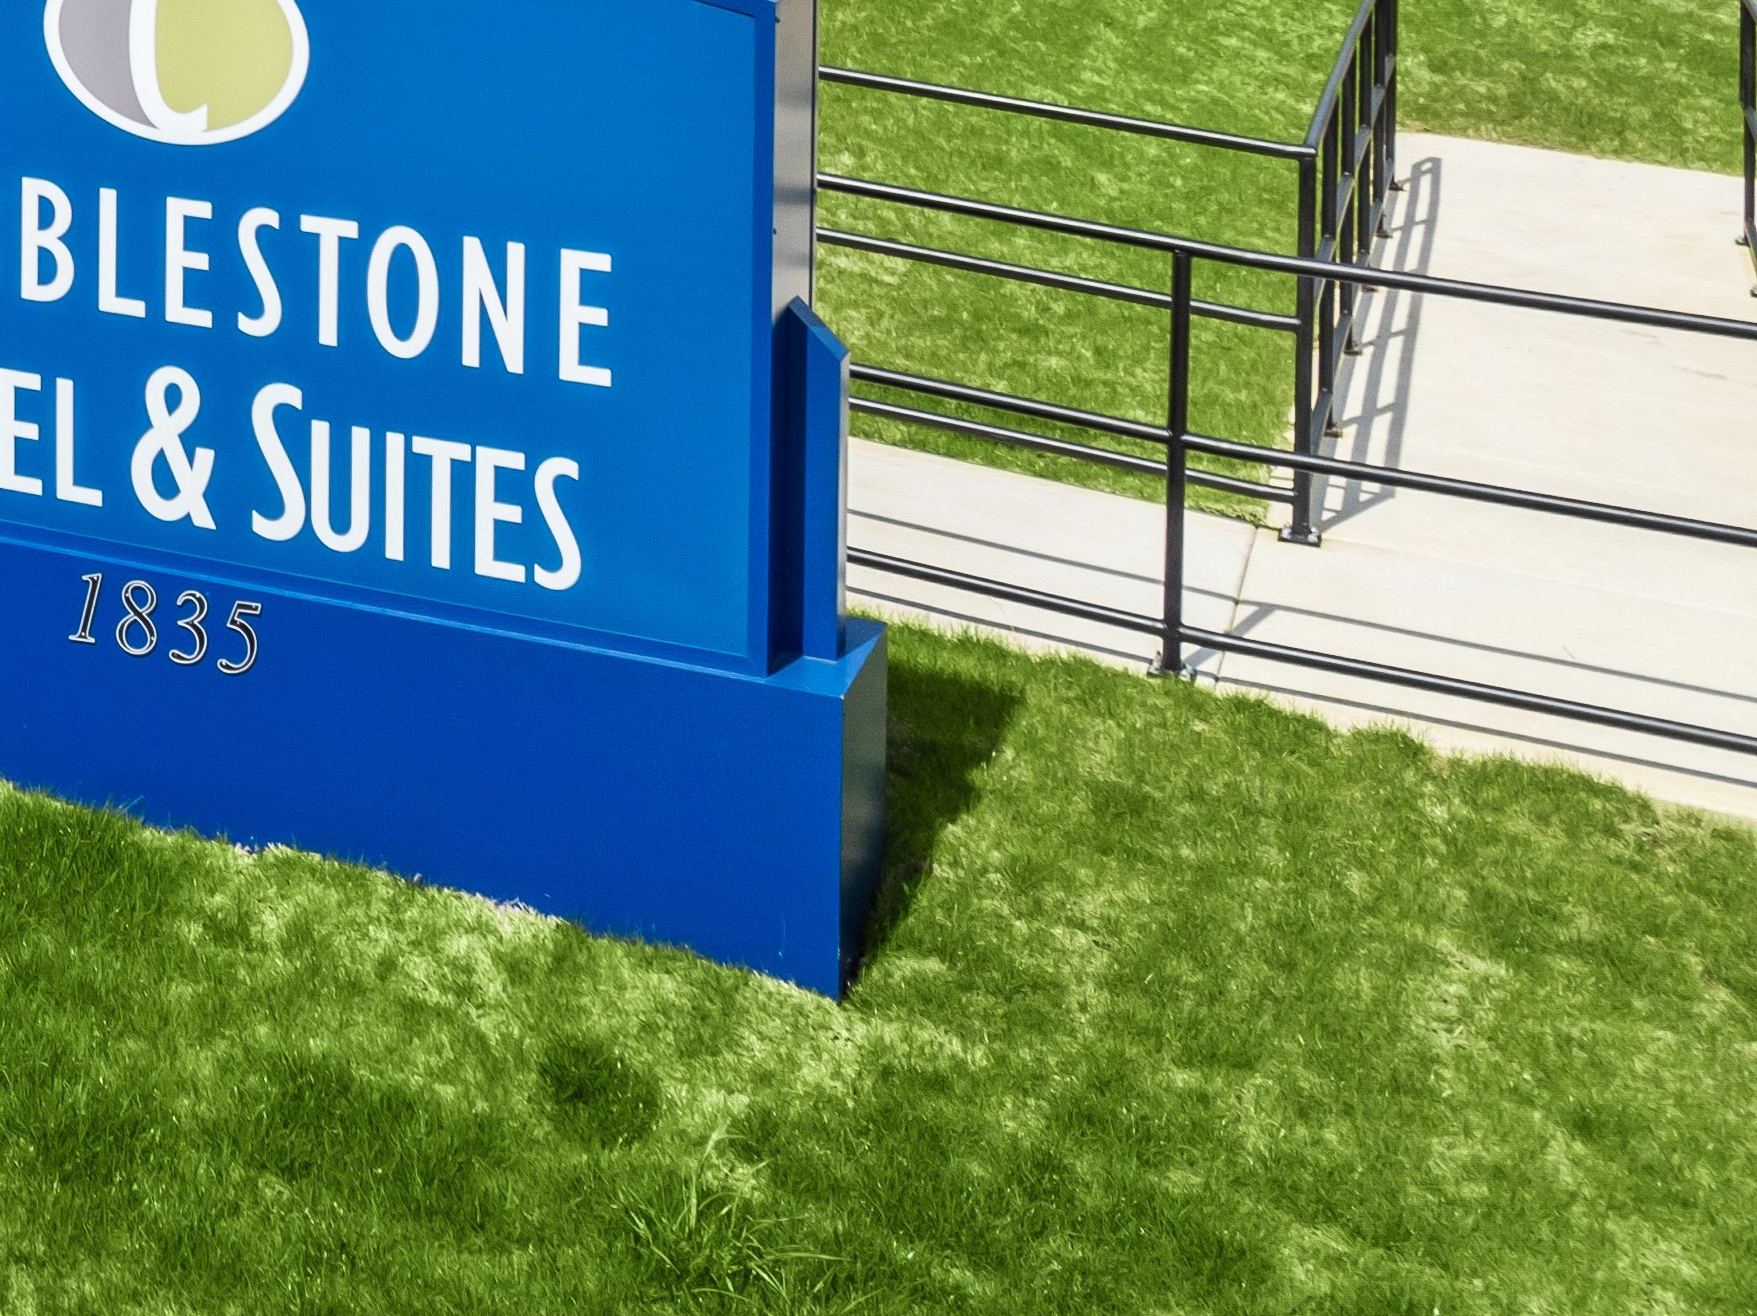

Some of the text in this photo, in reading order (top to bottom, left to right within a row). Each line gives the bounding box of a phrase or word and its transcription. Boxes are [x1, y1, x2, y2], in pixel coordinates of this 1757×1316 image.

[130, 365, 216, 530] &
[251, 383, 582, 591] SUITES
[68, 573, 262, 674] 1835
